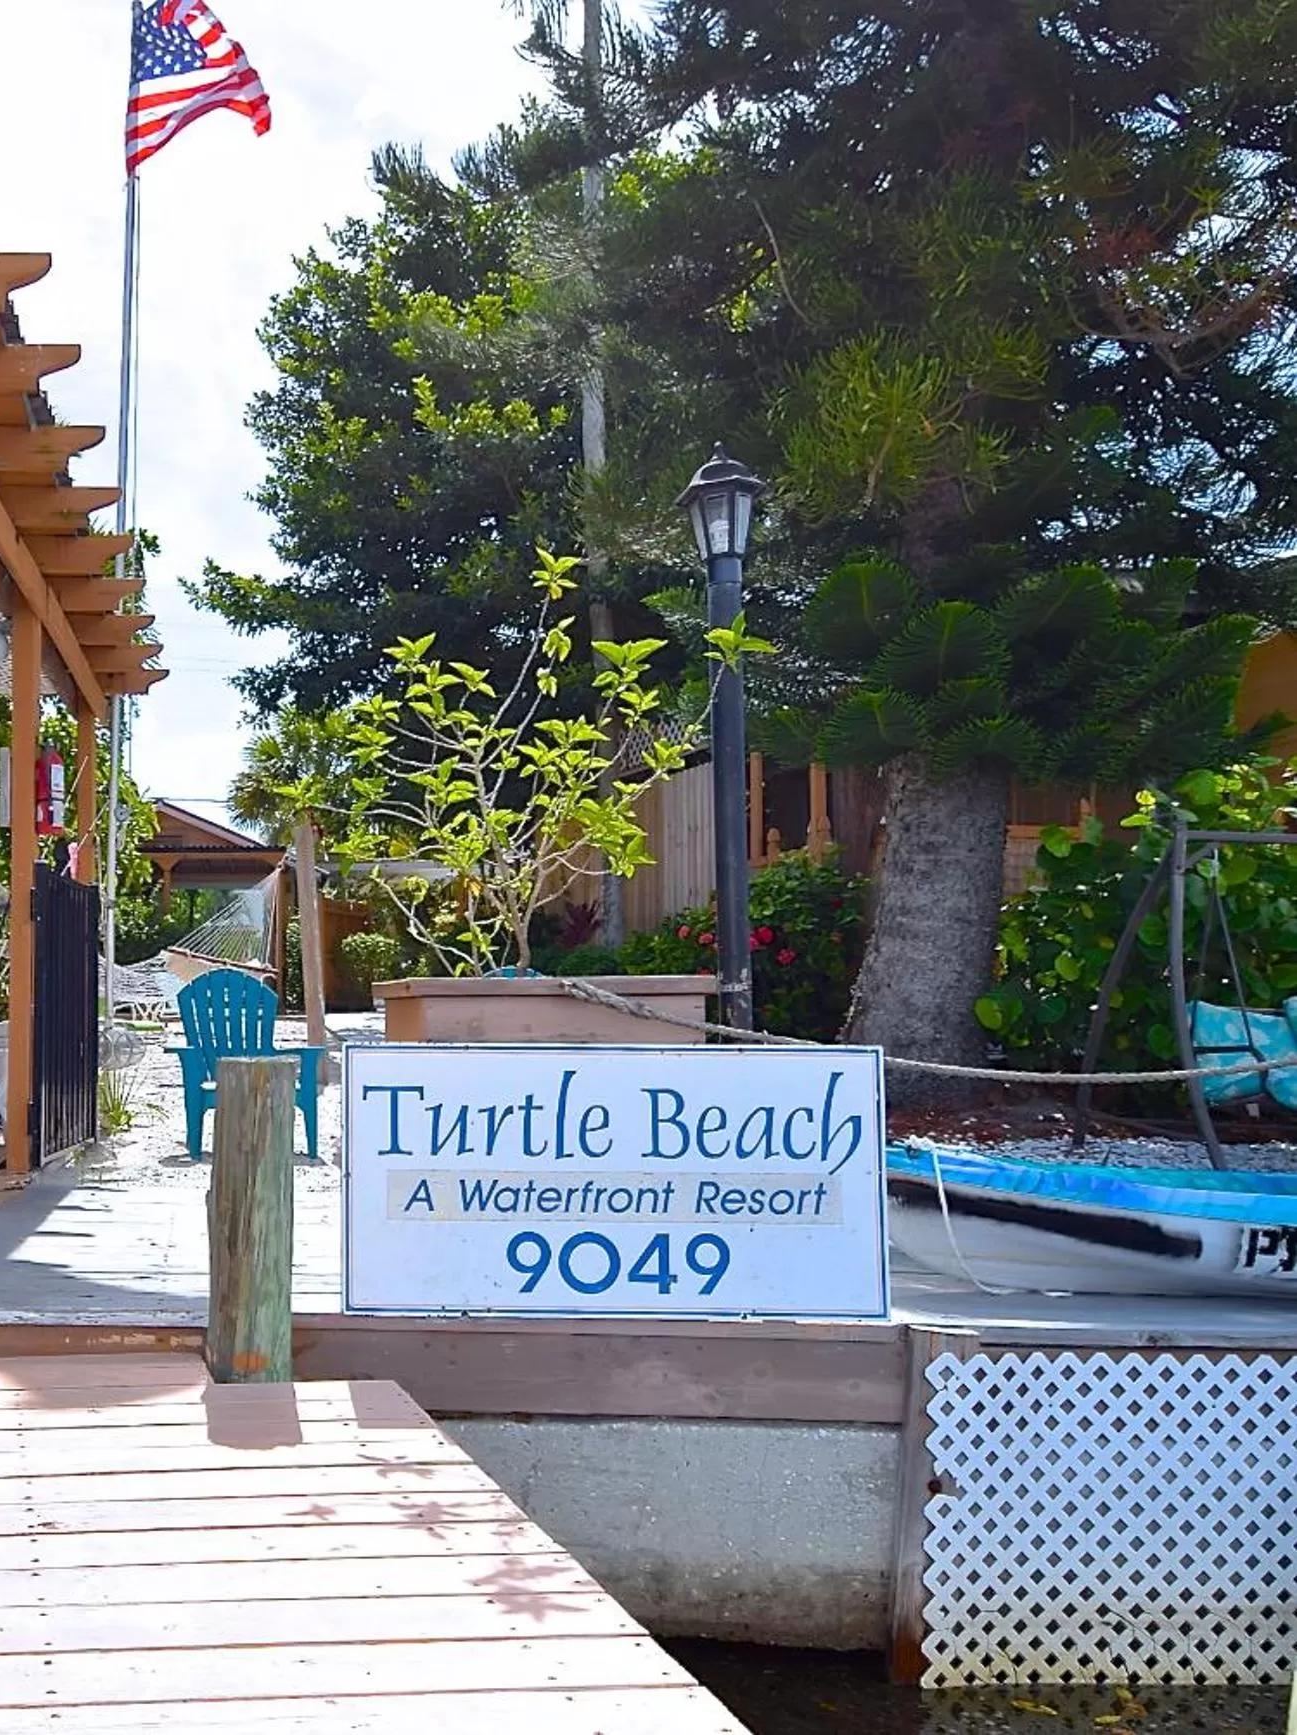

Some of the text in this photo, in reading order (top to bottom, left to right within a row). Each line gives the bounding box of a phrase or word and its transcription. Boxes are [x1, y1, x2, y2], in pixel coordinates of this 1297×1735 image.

[362, 1070, 862, 1177] Turtle Beach
[403, 1178, 828, 1216] A Waterfront Resort
[505, 1230, 731, 1296] 9049
